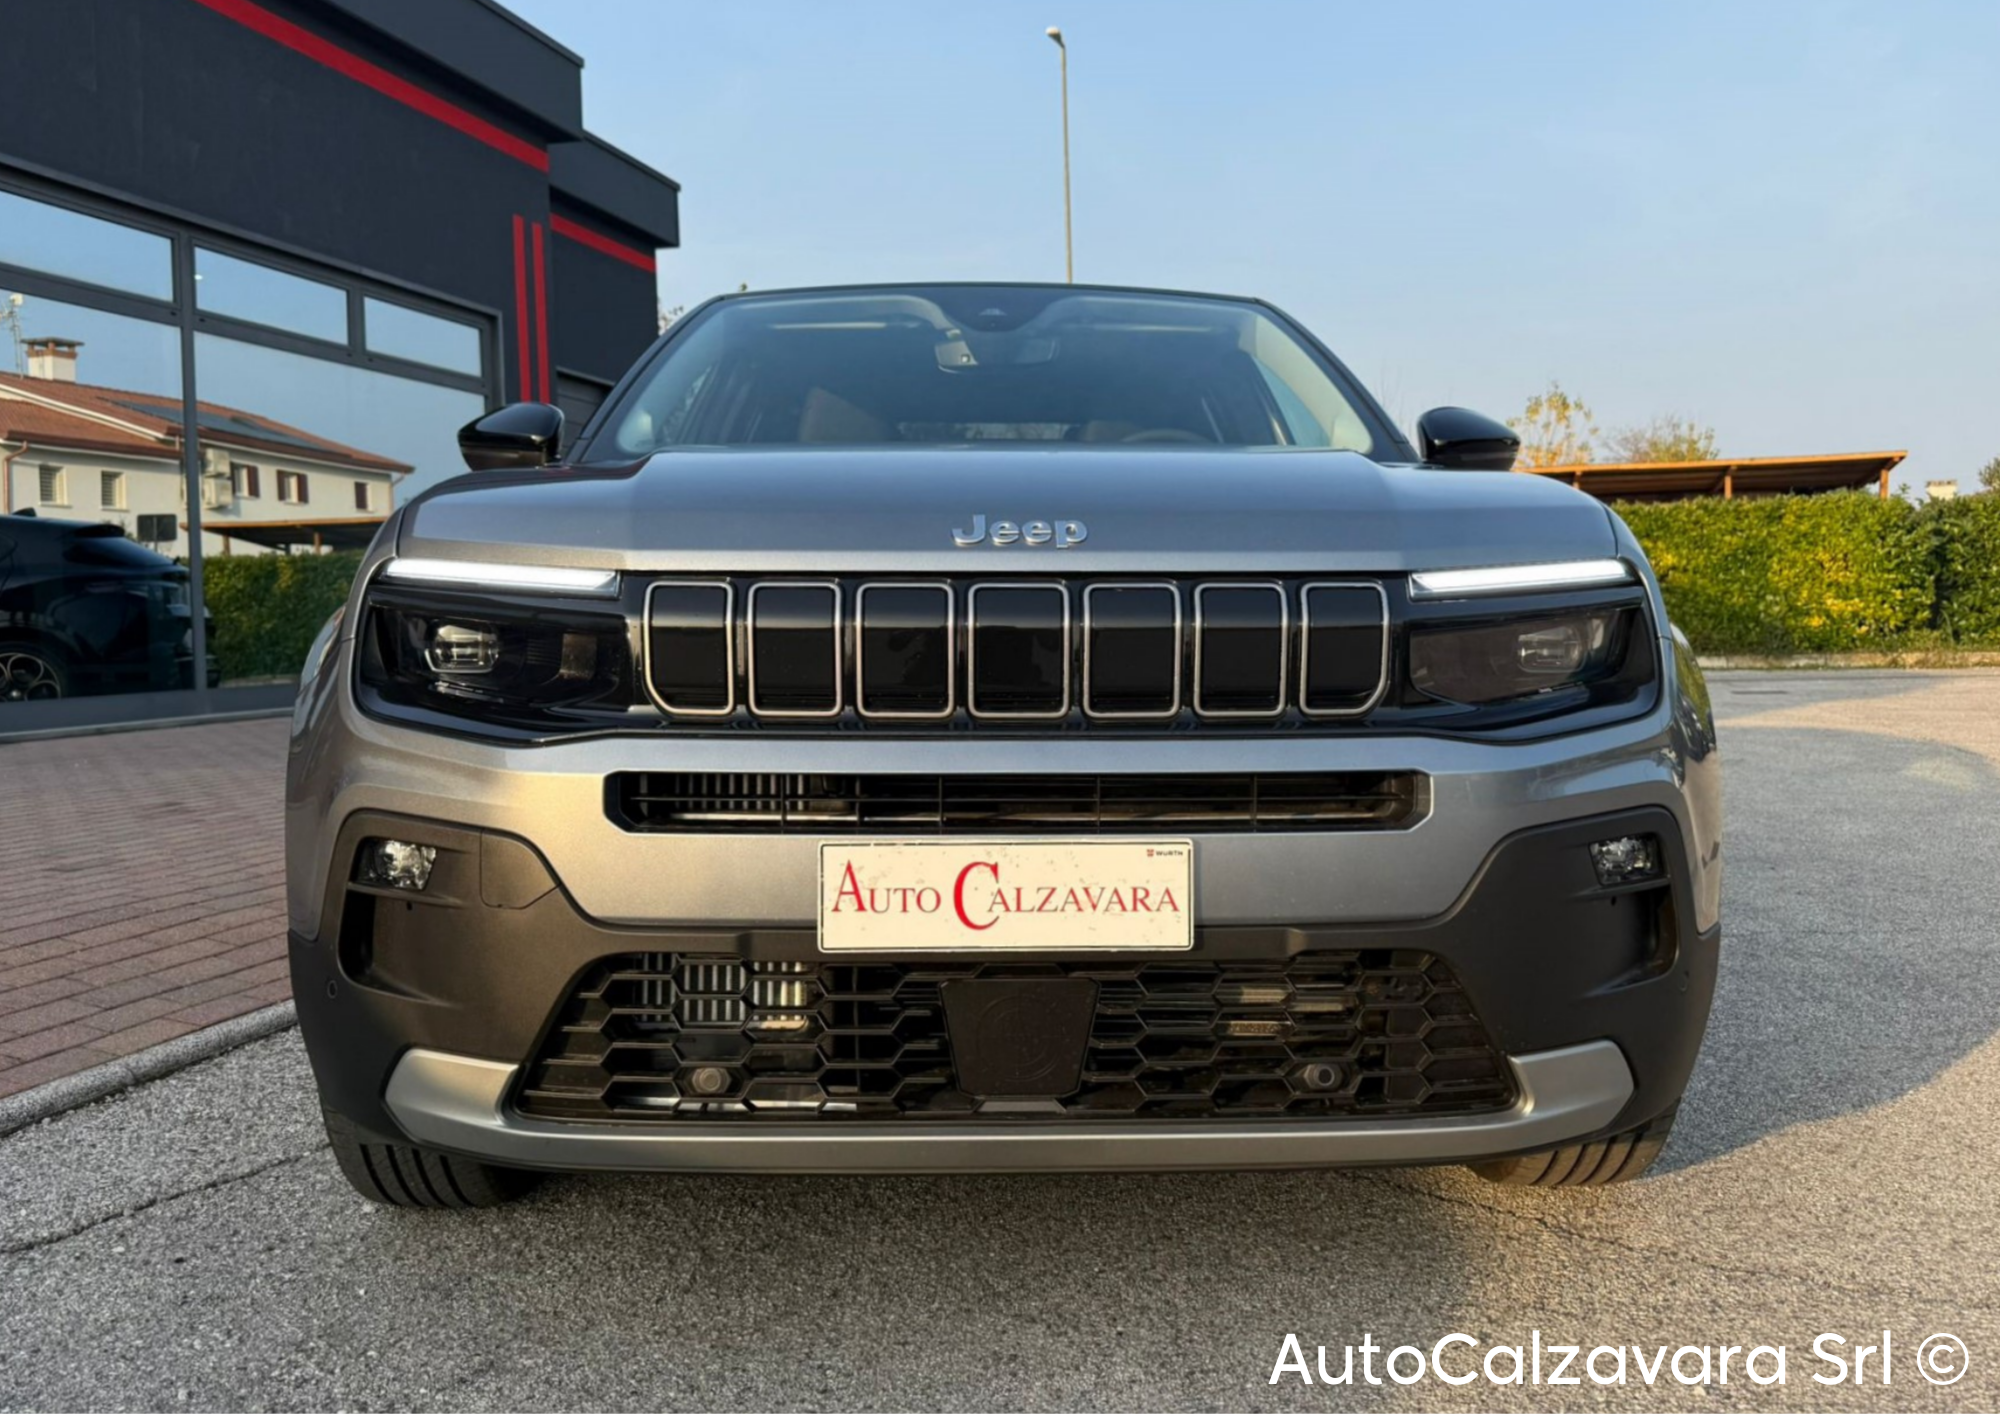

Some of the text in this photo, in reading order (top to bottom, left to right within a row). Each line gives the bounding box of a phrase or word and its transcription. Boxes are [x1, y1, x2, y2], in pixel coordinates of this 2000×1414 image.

[951, 514, 1088, 548] Jeep
[831, 860, 1181, 930] AUTO CALZAVARA
